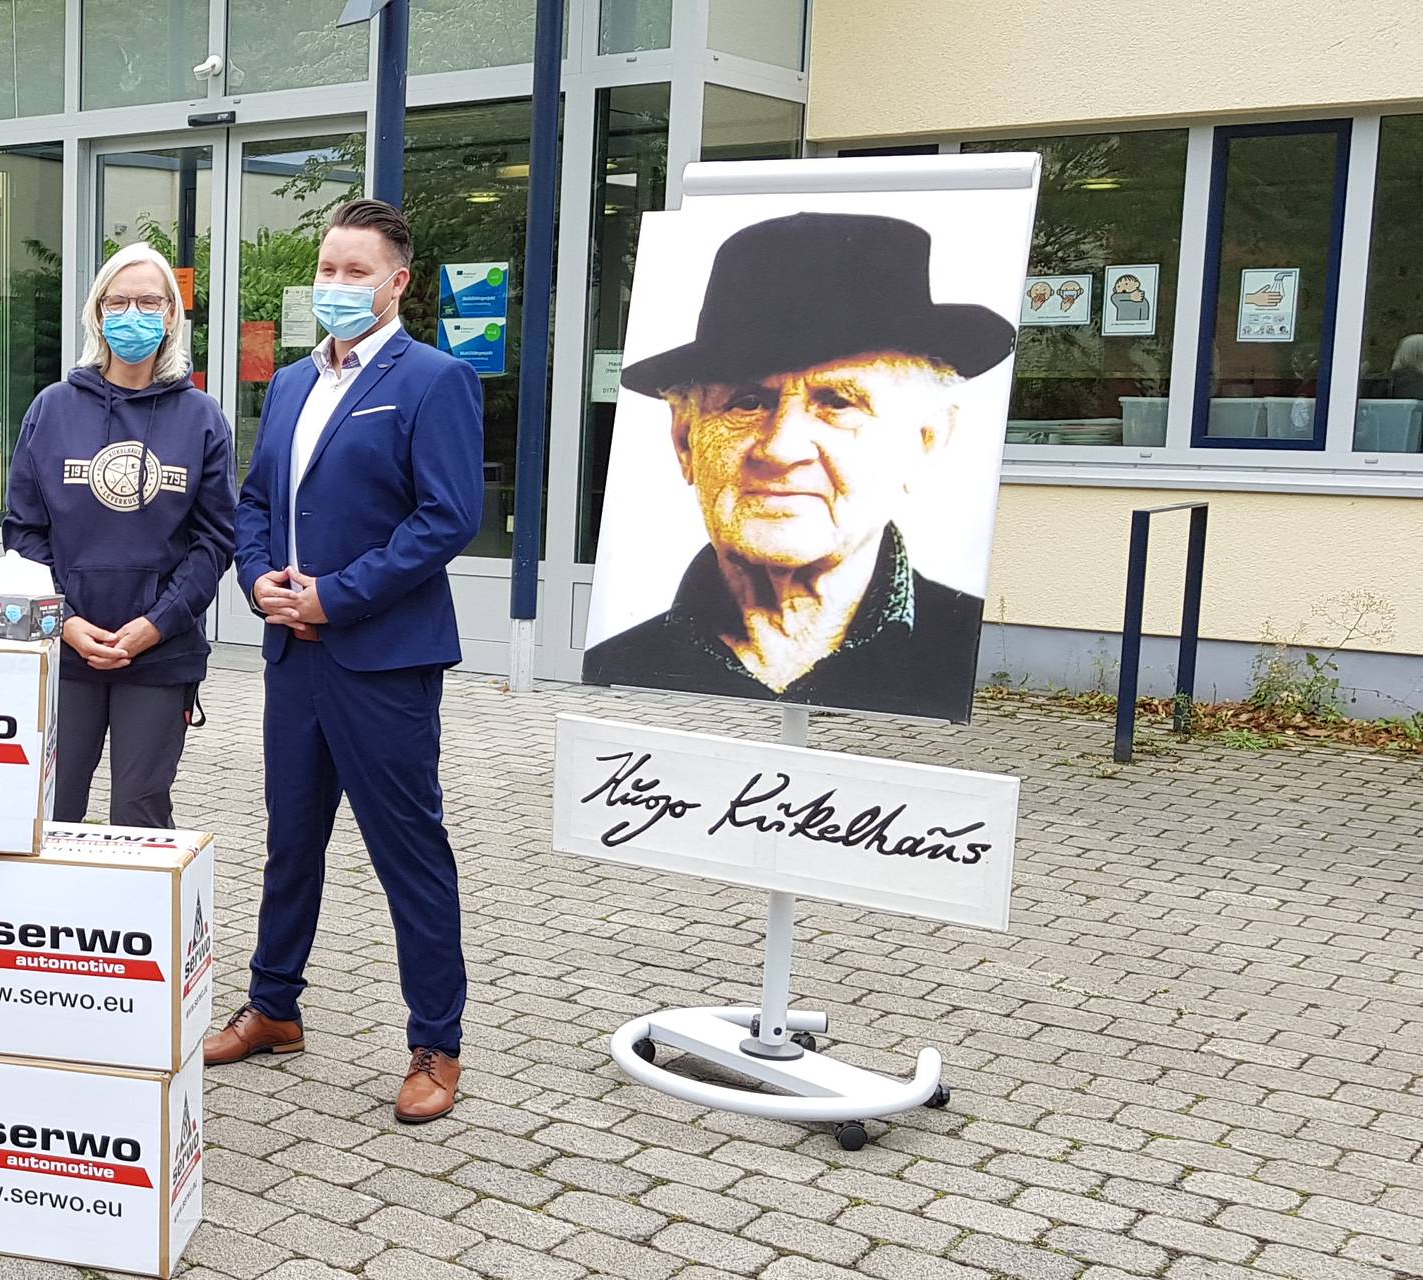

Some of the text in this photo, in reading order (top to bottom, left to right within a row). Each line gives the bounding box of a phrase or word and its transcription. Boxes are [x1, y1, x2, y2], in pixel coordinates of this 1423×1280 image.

[70, 465, 181, 486] 19 75
[15, 954, 126, 975] automotive
[6, 1153, 115, 1179] automotive
